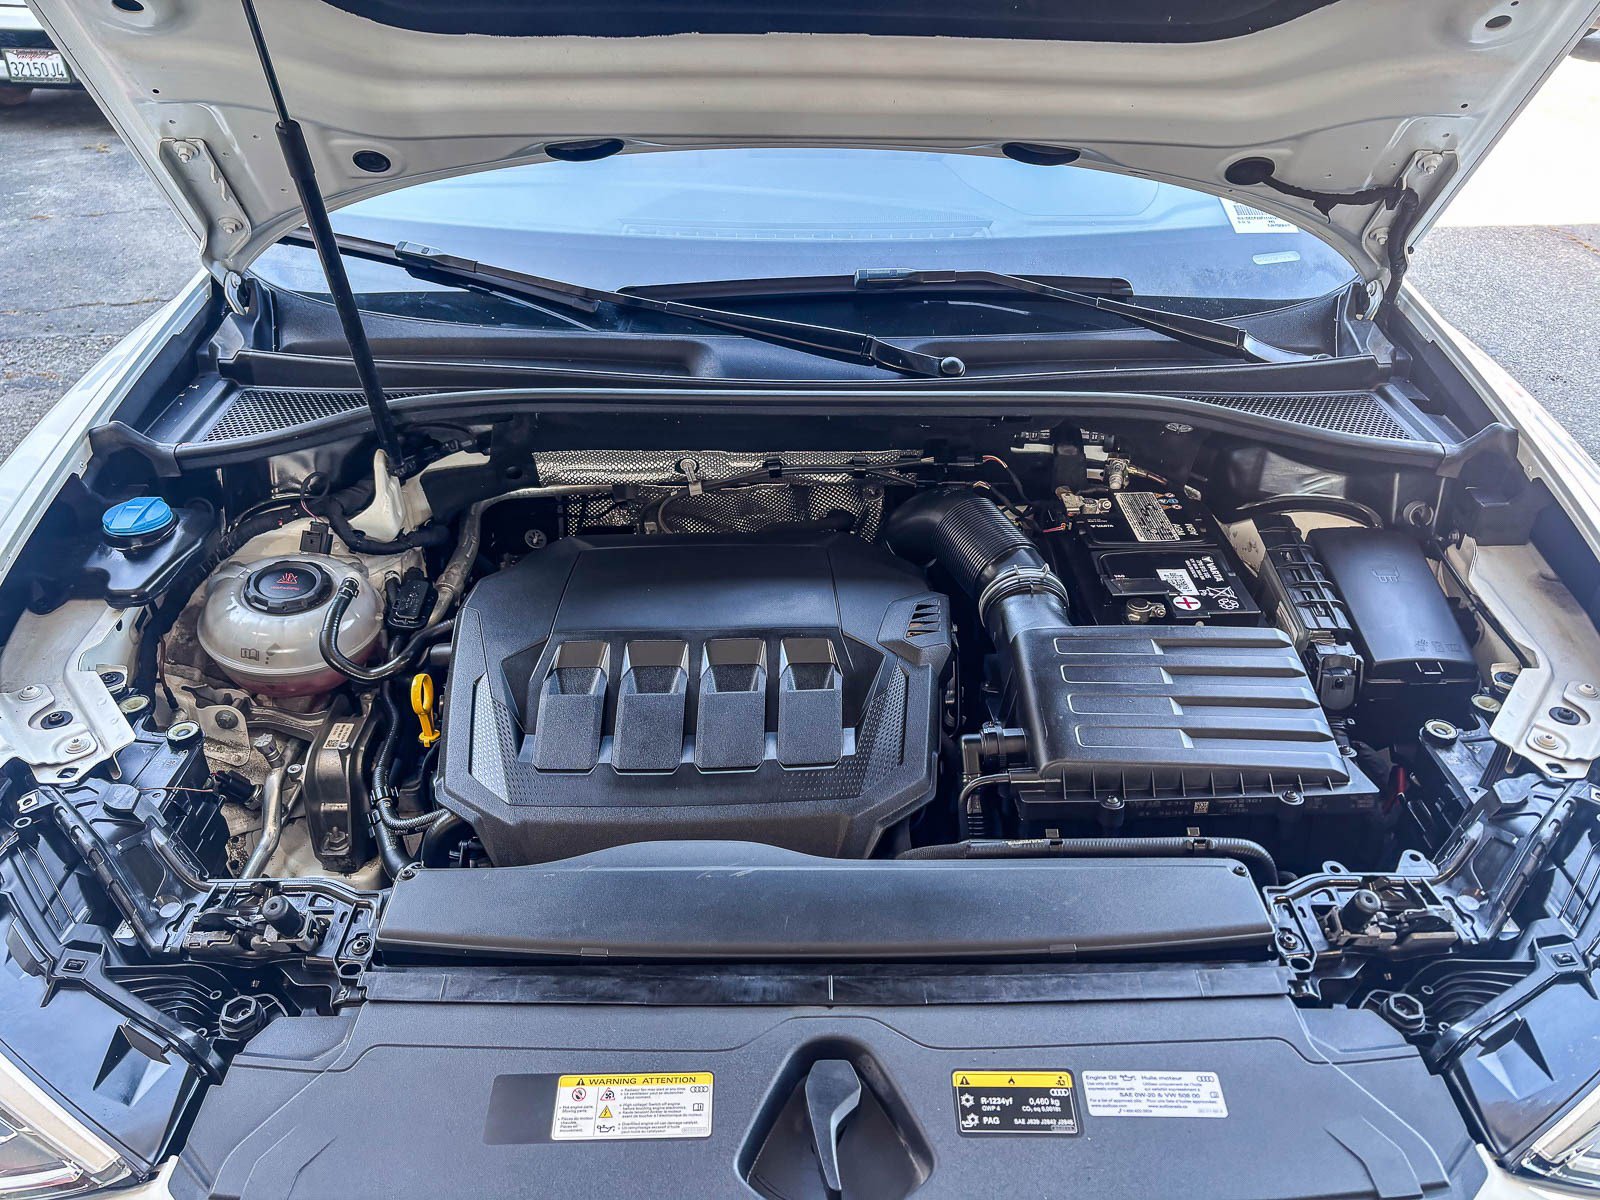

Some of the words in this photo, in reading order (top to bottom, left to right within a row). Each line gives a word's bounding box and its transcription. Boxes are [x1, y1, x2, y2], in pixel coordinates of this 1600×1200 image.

[10, 62, 65, 78] 32150J4
[1207, 562, 1224, 582] VARTA
[1050, 1098, 1060, 1106] kg
[983, 1116, 1000, 1124] PAG
